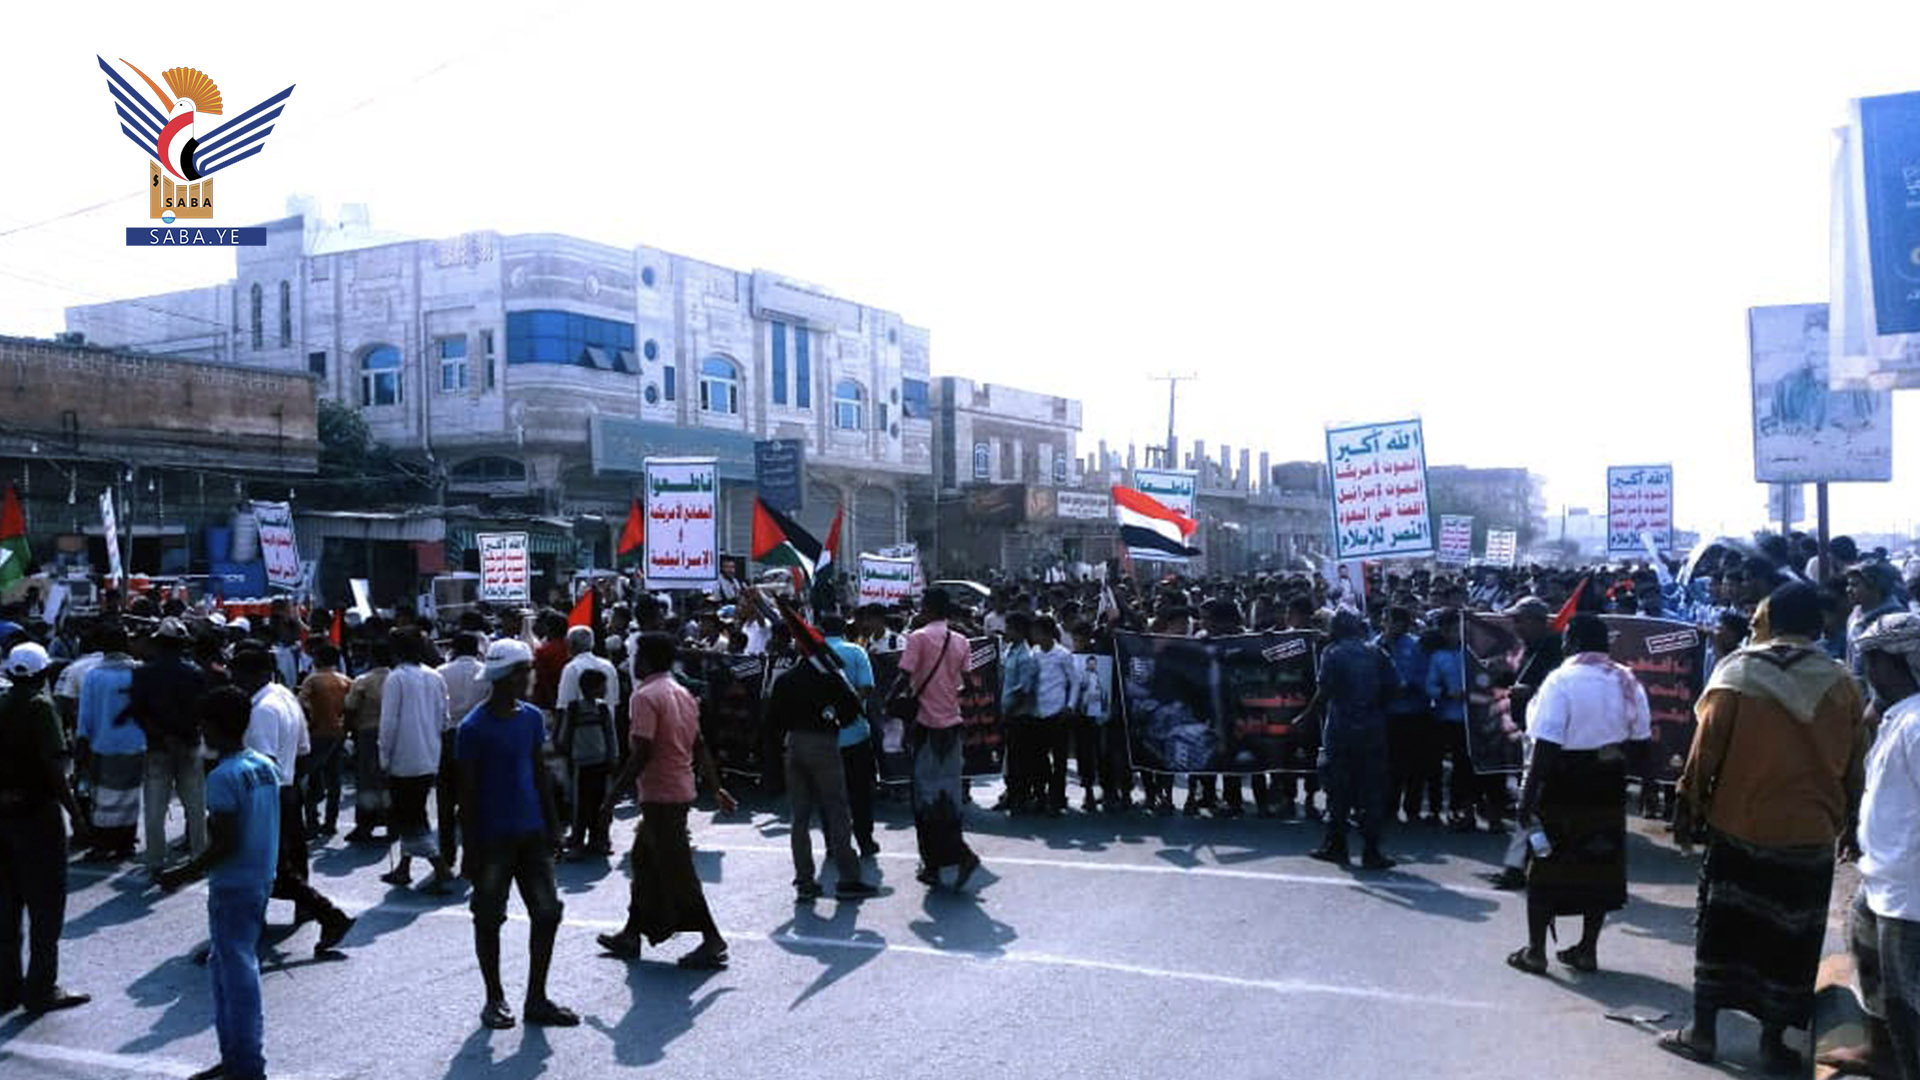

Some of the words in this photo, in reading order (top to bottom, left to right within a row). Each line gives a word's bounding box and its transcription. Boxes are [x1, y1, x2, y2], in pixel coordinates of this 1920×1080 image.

[1386, 430, 1419, 451] الله
[1383, 457, 1421, 476] الموت
[1385, 480, 1423, 497] الموت
[1389, 520, 1428, 547] النصر
